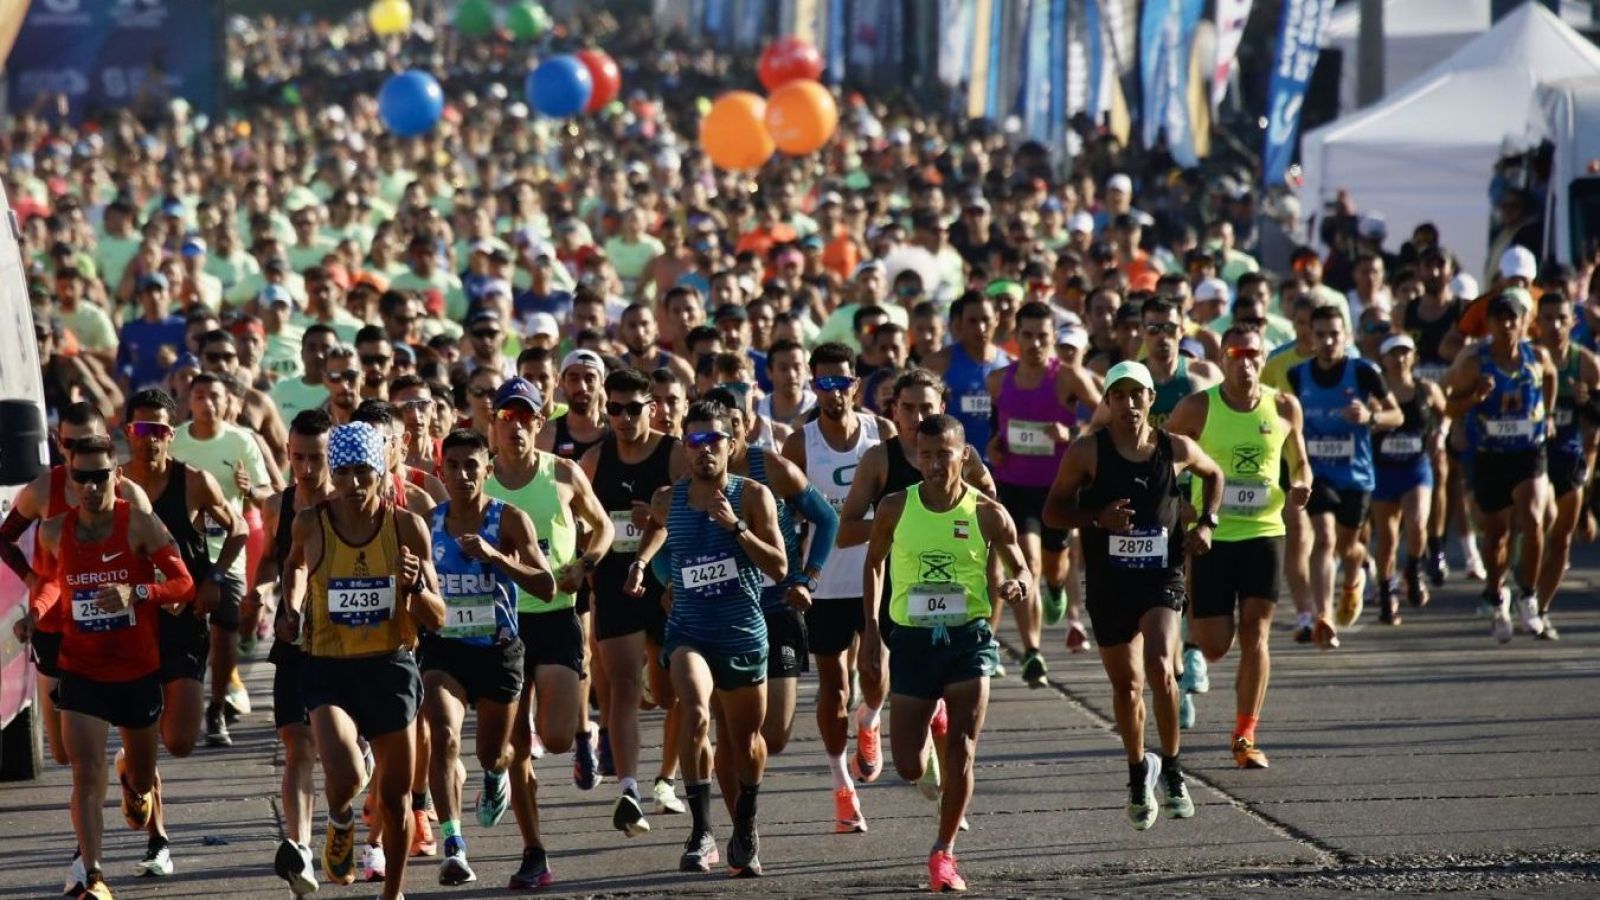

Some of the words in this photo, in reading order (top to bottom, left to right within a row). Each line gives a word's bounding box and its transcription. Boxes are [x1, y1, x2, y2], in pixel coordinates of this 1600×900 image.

[1238, 490, 1255, 503] 09
[1118, 540, 1153, 553] 2878
[65, 569, 129, 585] EJERCITO
[689, 563, 728, 584] 2422
[437, 573, 496, 594] PERU
[340, 592, 380, 608] 2438
[927, 598, 947, 612] 04
[80, 603, 117, 618] 25
[456, 610, 474, 624] 11
